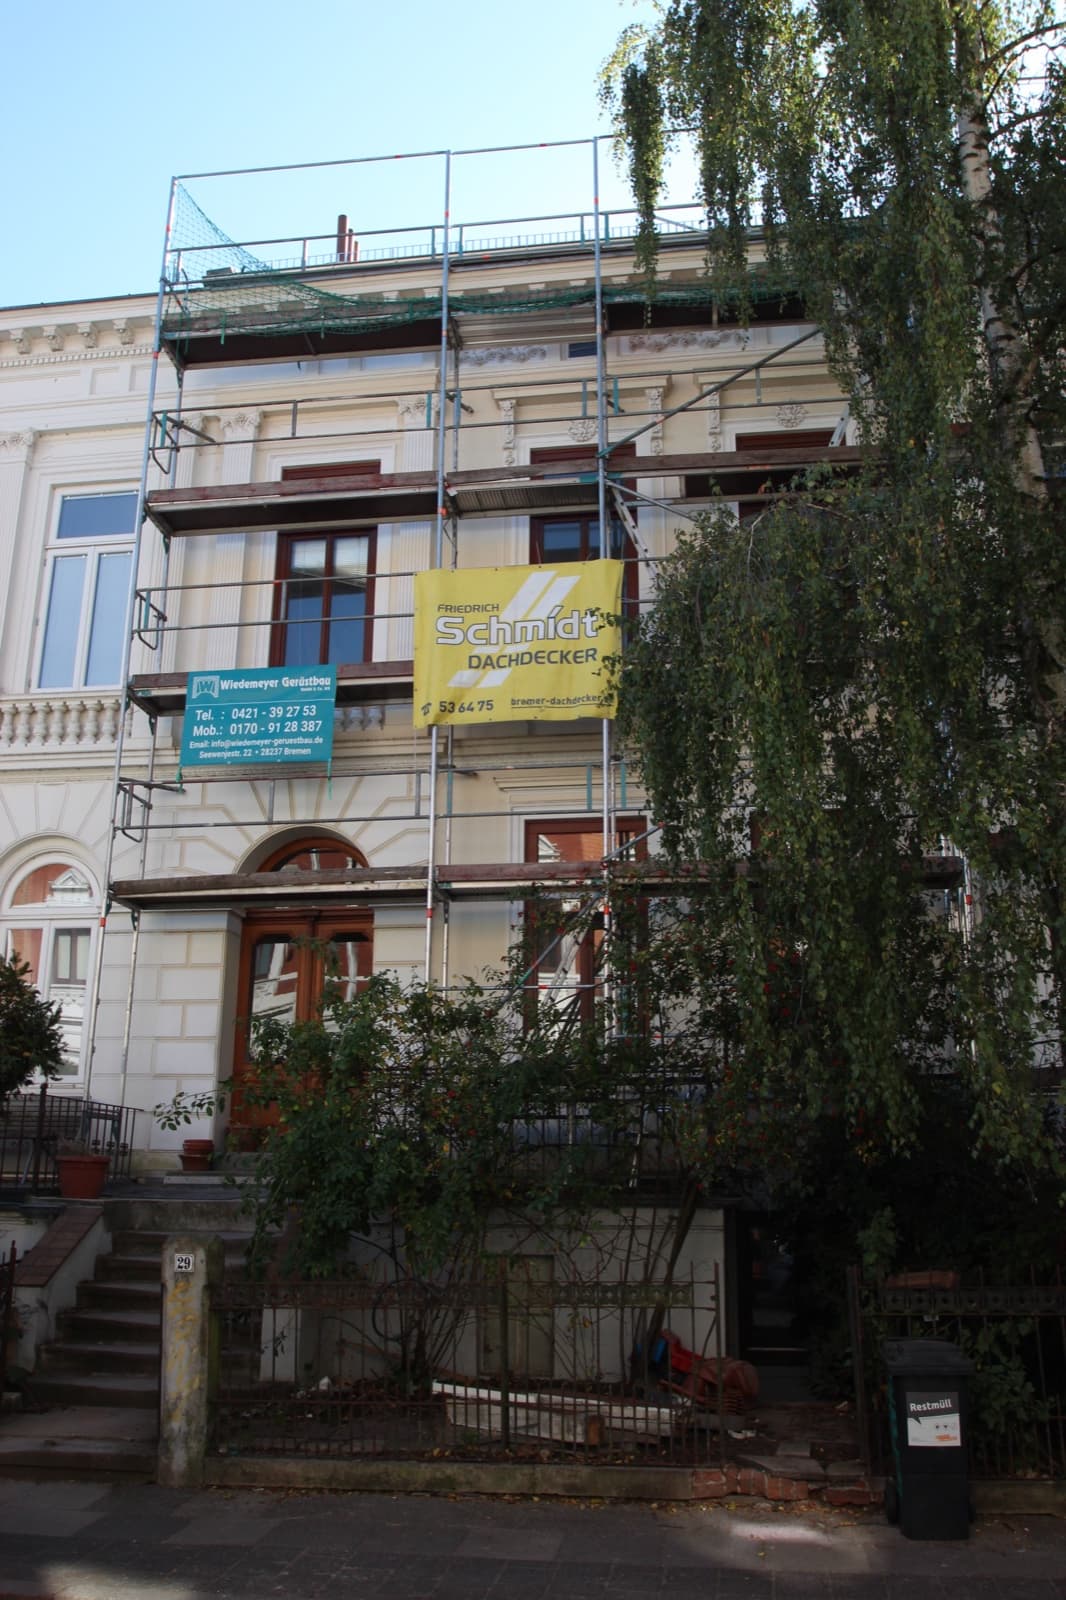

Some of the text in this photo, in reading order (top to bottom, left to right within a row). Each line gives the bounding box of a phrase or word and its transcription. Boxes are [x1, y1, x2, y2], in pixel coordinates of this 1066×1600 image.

[437, 604, 499, 613] FRIEDRICH
[468, 648, 597, 669] DACHDECKER
[221, 676, 331, 690] Wiedemeyer Gerüstbau
[439, 699, 494, 713] 53 64 75
[196, 710, 214, 721] Tel.
[232, 708, 258, 719] 0421
[269, 706, 283, 718] 39
[286, 706, 299, 717] 27
[303, 705, 316, 716] 53
[230, 723, 257, 734] 0170
[268, 722, 280, 733] 91
[284, 721, 298, 732] 28
[301, 721, 322, 731] 387
[189, 741, 209, 749] Email:
[243, 749, 252, 757] 22
[177, 1257, 190, 1269] 29
[910, 1399, 952, 1411] Restmüll
